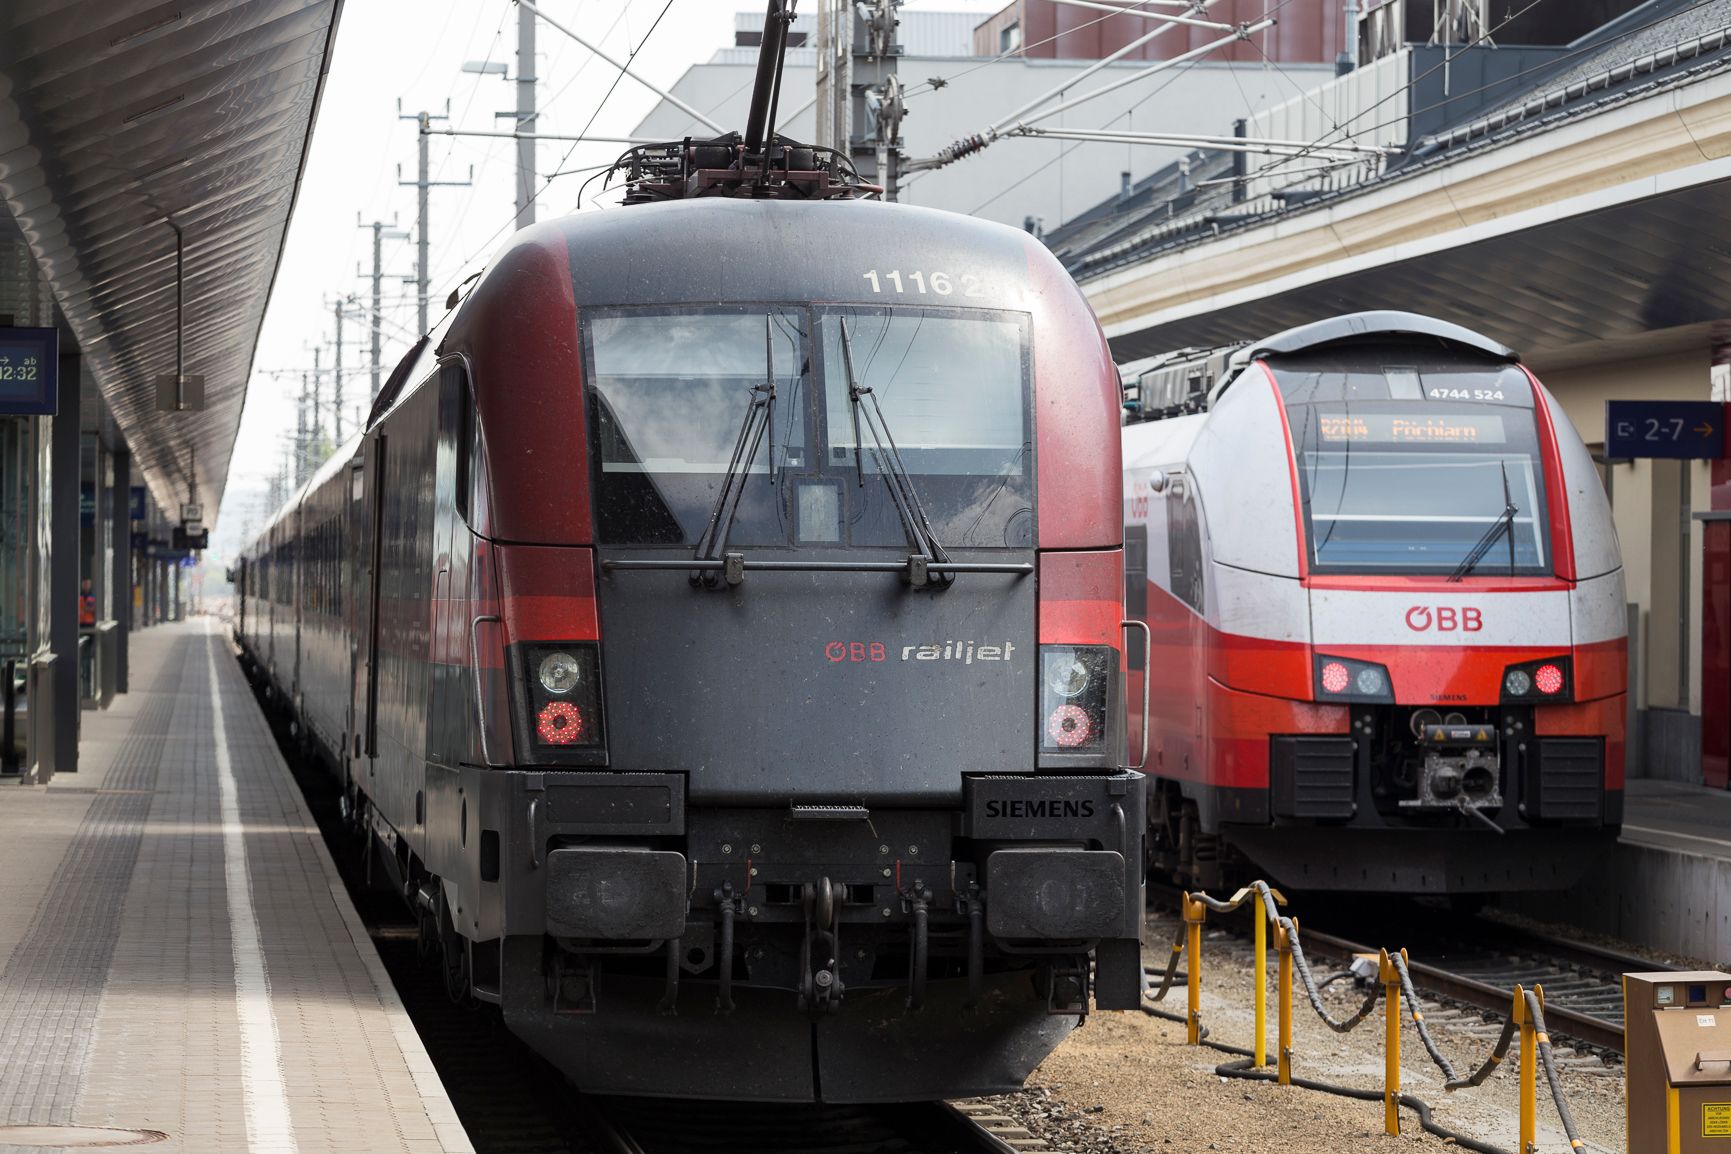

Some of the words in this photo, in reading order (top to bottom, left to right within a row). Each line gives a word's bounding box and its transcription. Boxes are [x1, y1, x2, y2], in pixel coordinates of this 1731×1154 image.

[863, 269, 953, 296] 1116
[23, 357, 37, 365] ab
[1429, 388, 1470, 399] 4744
[1474, 389, 1504, 400] 524
[1644, 418, 1684, 441] 2-7
[1405, 605, 1483, 632] ÖBB
[825, 640, 887, 663] ÖBB
[901, 640, 1016, 665] railjet
[1429, 693, 1468, 701] SIEMENS
[985, 799, 1095, 818] SIEMENS
